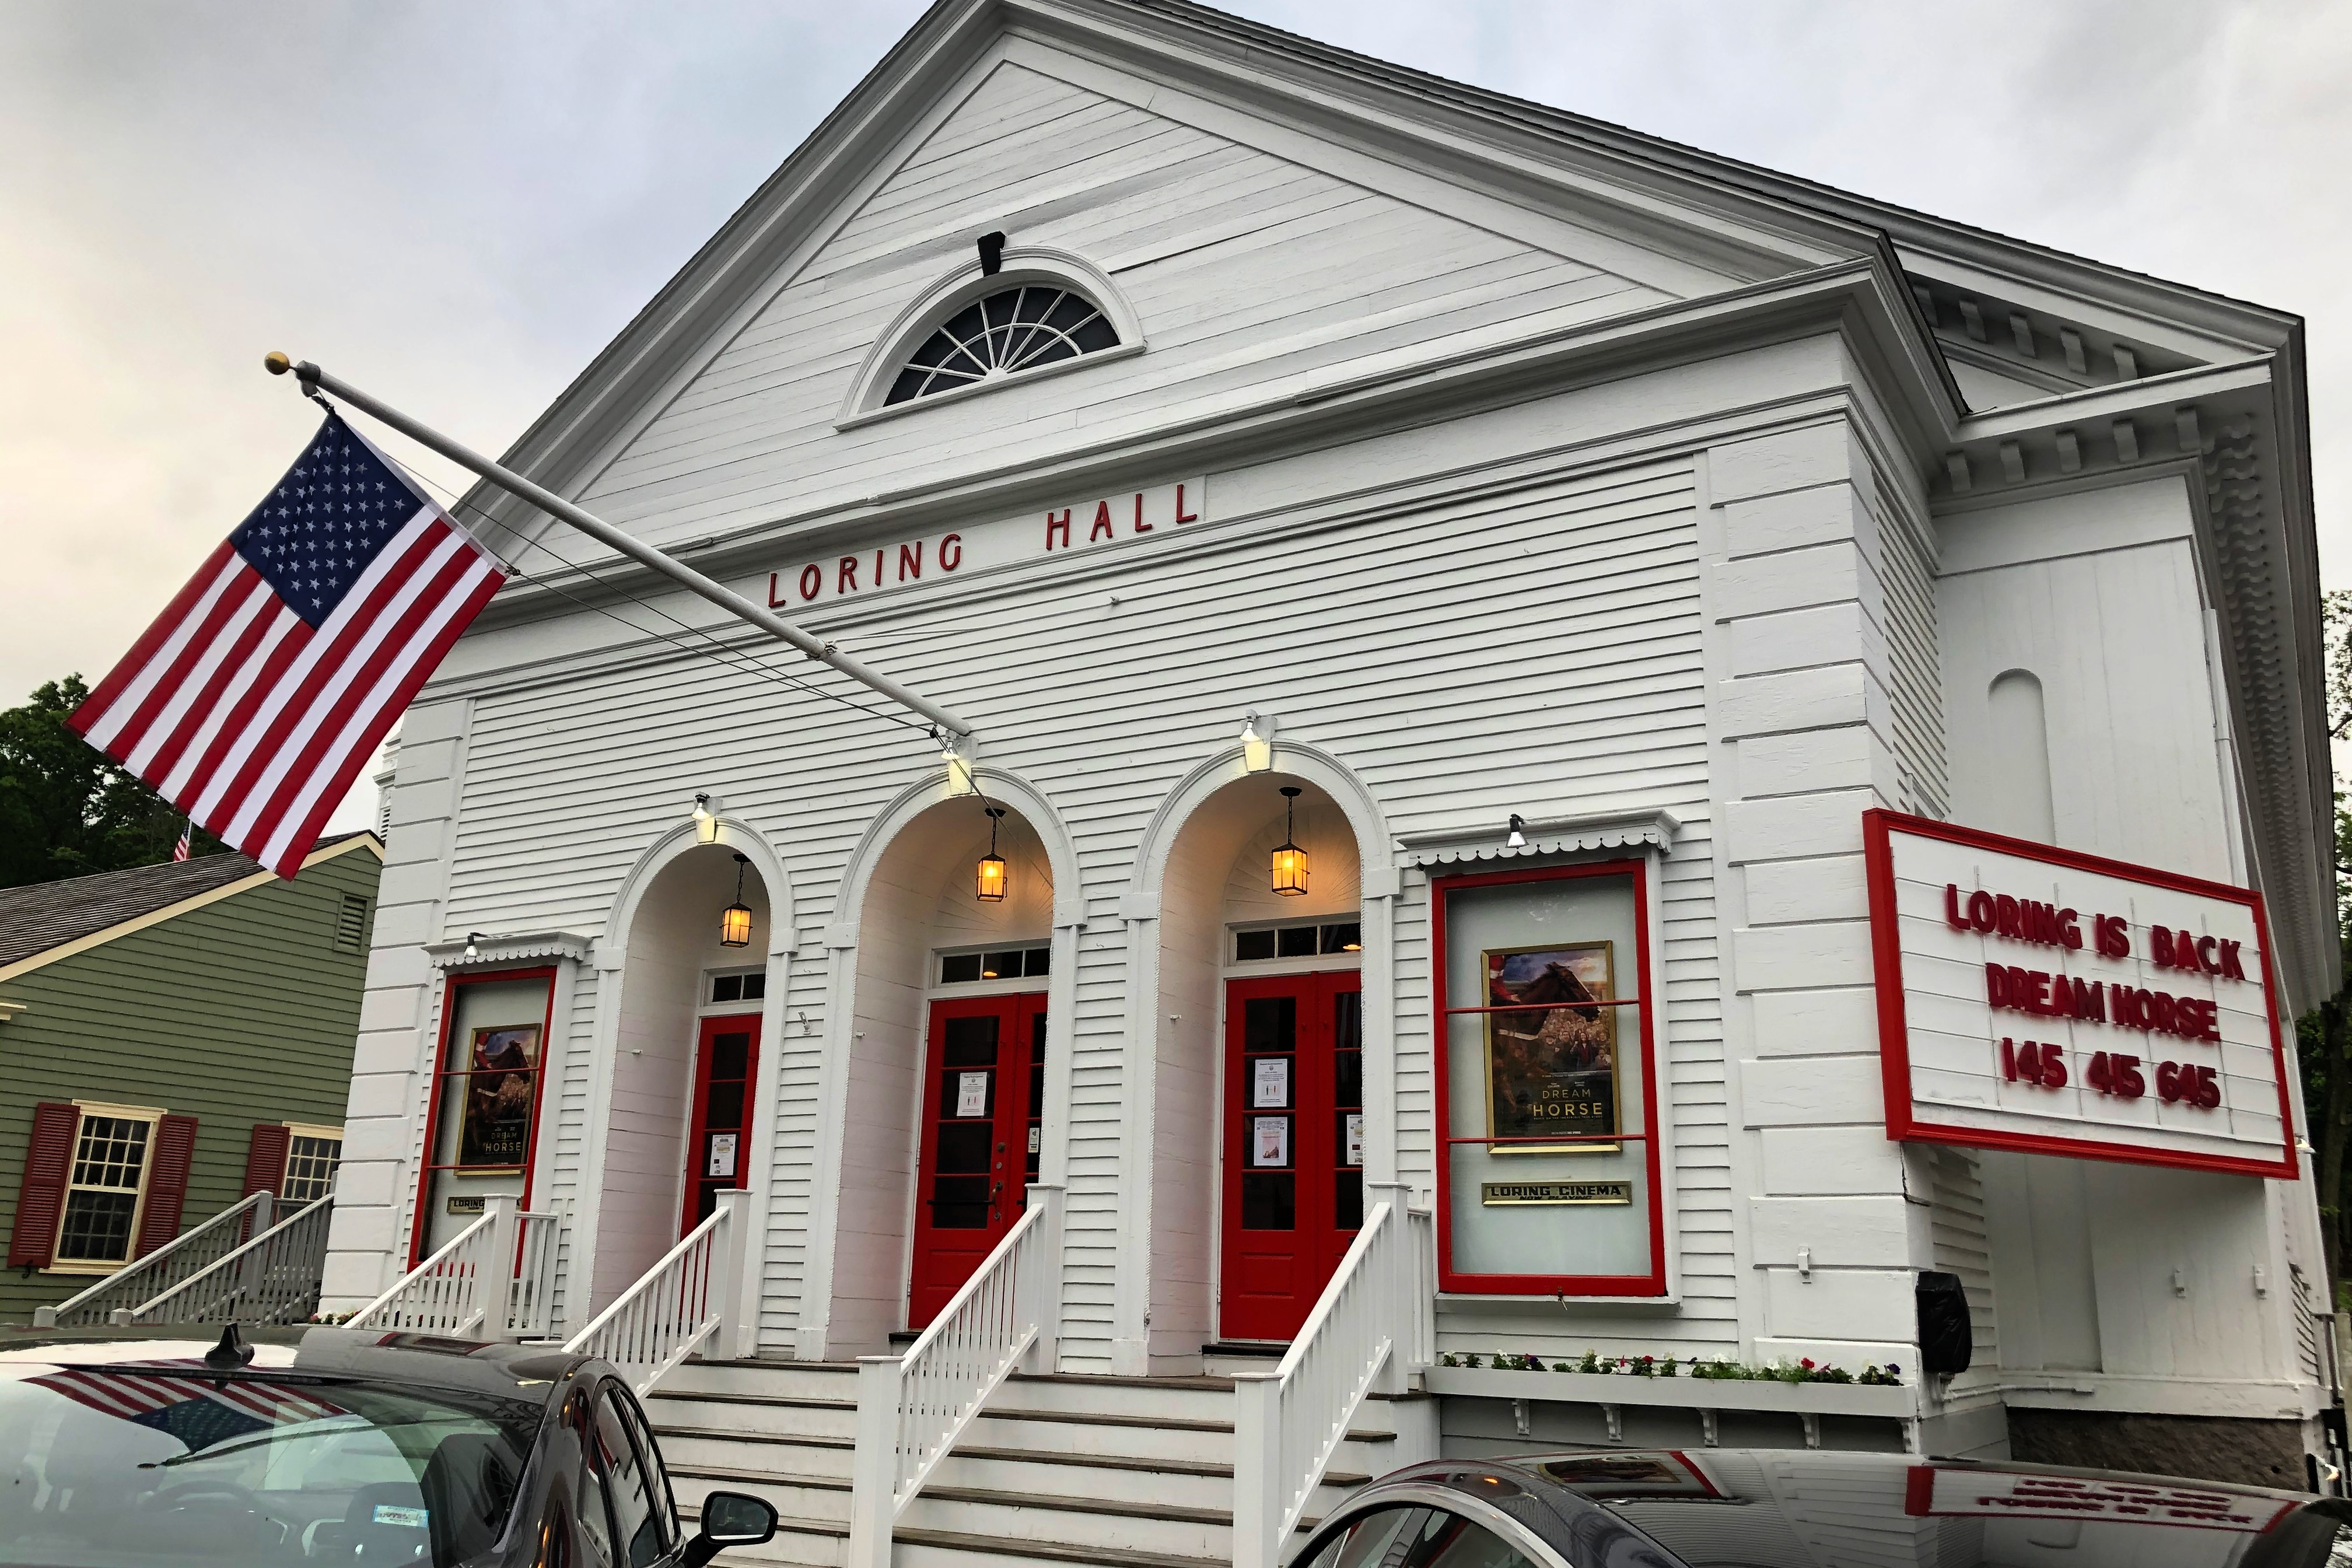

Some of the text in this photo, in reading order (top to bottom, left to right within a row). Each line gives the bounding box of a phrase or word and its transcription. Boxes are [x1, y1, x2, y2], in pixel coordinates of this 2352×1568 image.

[768, 484, 1197, 608] LORING HALL
[1947, 884, 2246, 981] LORING IS BACK
[1986, 962, 2221, 1041] DREAM HORSE
[1542, 1088, 1591, 1099] DREAM
[2002, 1037, 2221, 1108] 145 415 645
[1533, 1102, 1602, 1116] HORSE
[485, 1142, 521, 1152] HORSE
[1490, 1185, 1622, 1196] LORING CINEMA
